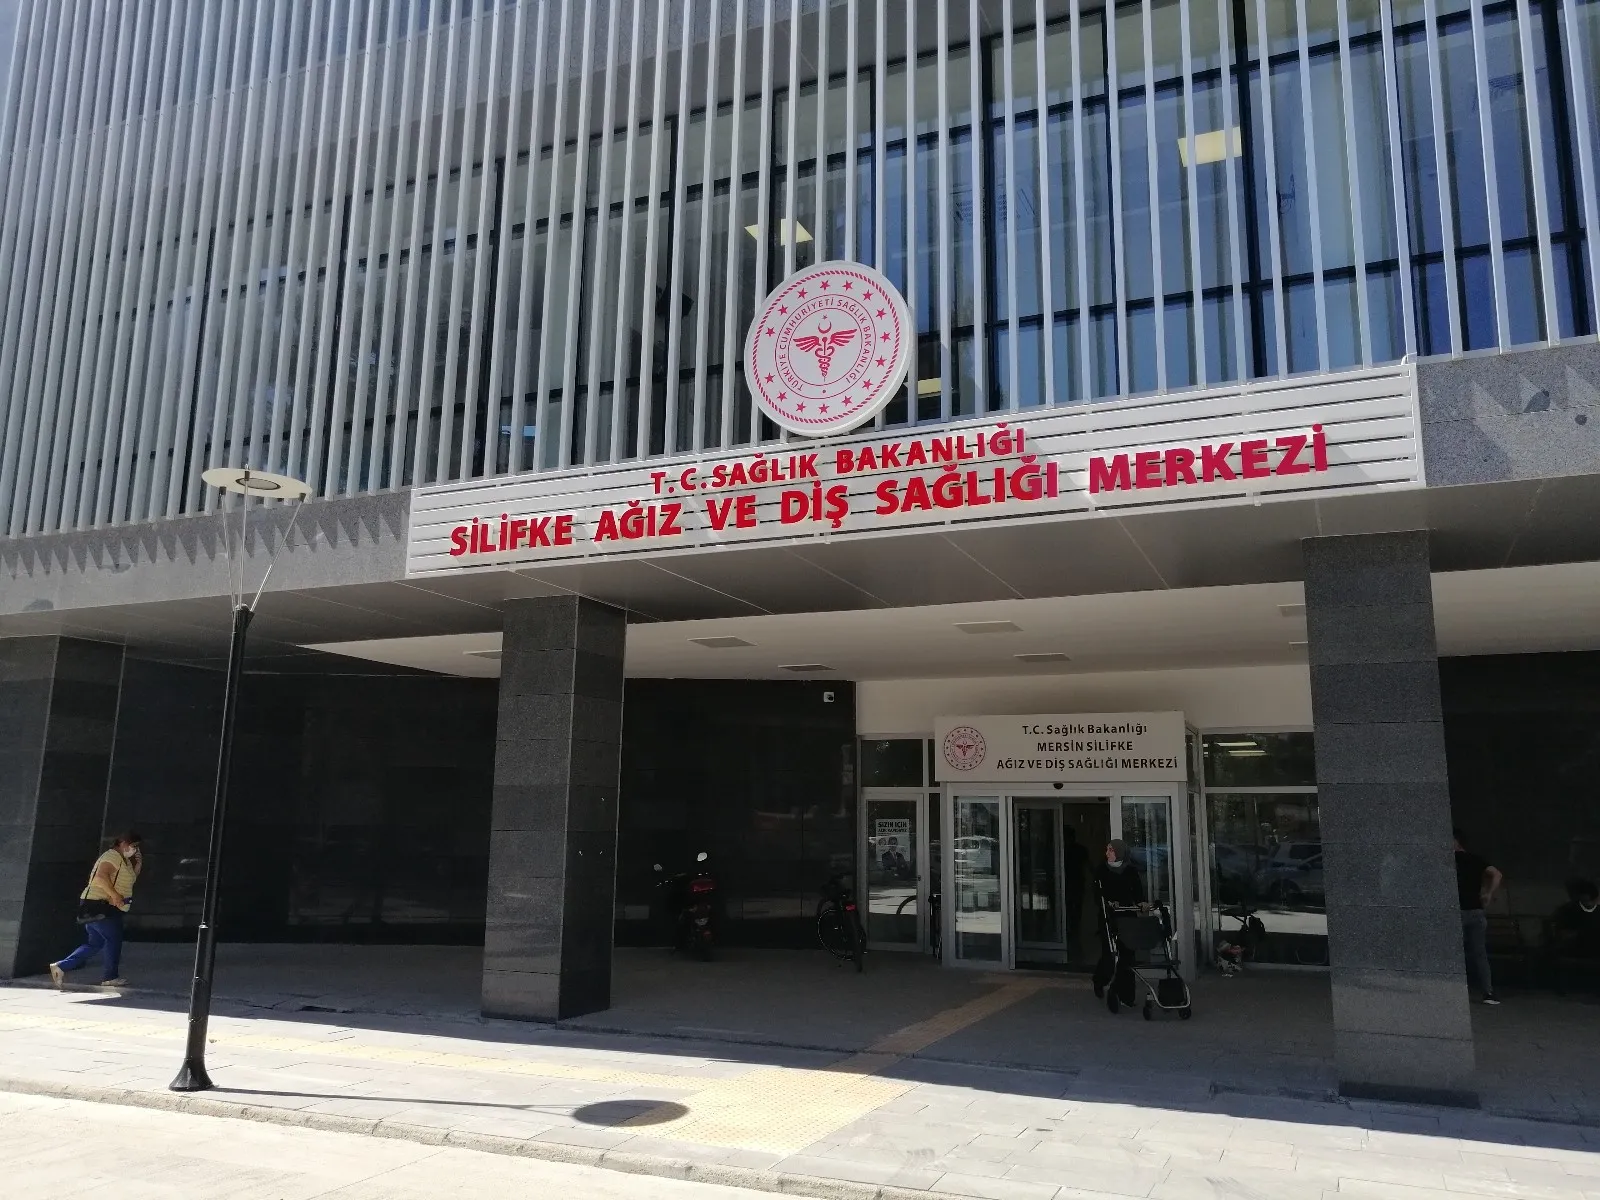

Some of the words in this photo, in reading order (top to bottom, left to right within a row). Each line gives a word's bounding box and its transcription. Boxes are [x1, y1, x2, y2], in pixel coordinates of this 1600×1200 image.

[779, 298, 834, 350] CUMHURİYETİ
[837, 298, 867, 324] SAĞLIK
[845, 326, 872, 384] BAKANLIĞI
[836, 423, 1025, 479] BAKANLIĞI
[449, 514, 574, 557] SİLİFKE
[594, 499, 683, 544] AĞIZ
[705, 494, 758, 532] VE
[780, 478, 850, 530] DİŞ
[875, 454, 1059, 517] SAĞLIĞI
[1088, 423, 1330, 495] MERKEZİ
[1037, 739, 1084, 752] MERSİN
[1086, 739, 1134, 752] SİLİFKE
[1046, 724, 1085, 737] Sağlık
[1087, 722, 1148, 736] Bakanlığı
[996, 757, 1025, 769] AĞIZ
[1027, 758, 1043, 769] VE
[1045, 756, 1066, 772] DİŞ
[1068, 756, 1119, 769] SAĞLIĞI
[1121, 756, 1179, 769] MERKEZİ
